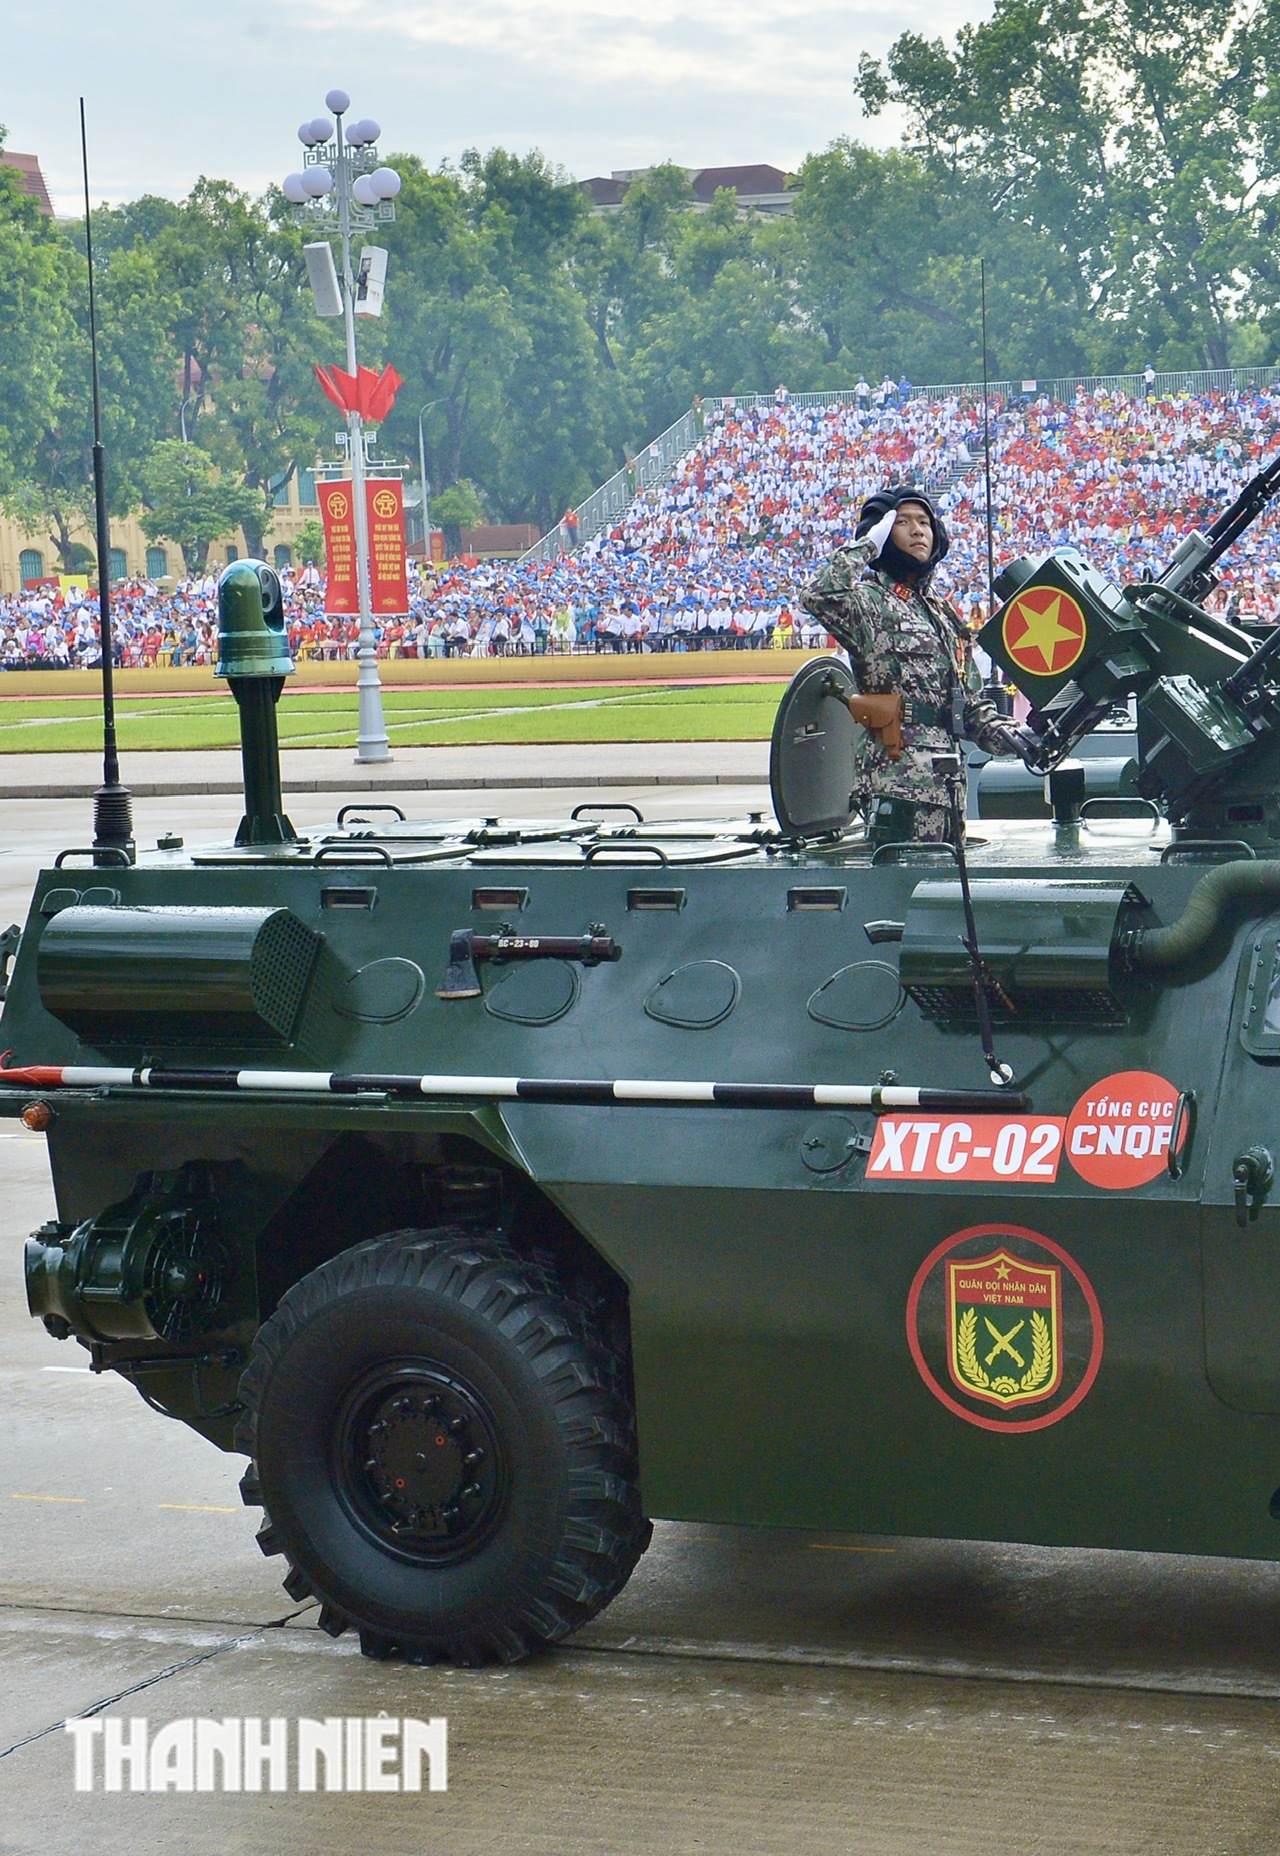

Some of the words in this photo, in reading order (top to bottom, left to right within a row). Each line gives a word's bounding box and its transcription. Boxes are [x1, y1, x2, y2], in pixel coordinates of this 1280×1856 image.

[1087, 1096, 1132, 1117] TỔNG
[1138, 1102, 1173, 1120] CỤC
[870, 1122, 1061, 1175] XTC-02
[959, 1279, 983, 1290] QUÂN
[1003, 1281, 1026, 1292] NHÂN
[1029, 1282, 1047, 1294] DÂN
[983, 1294, 1002, 1304] VIỆT
[1005, 1295, 1024, 1304] NAM
